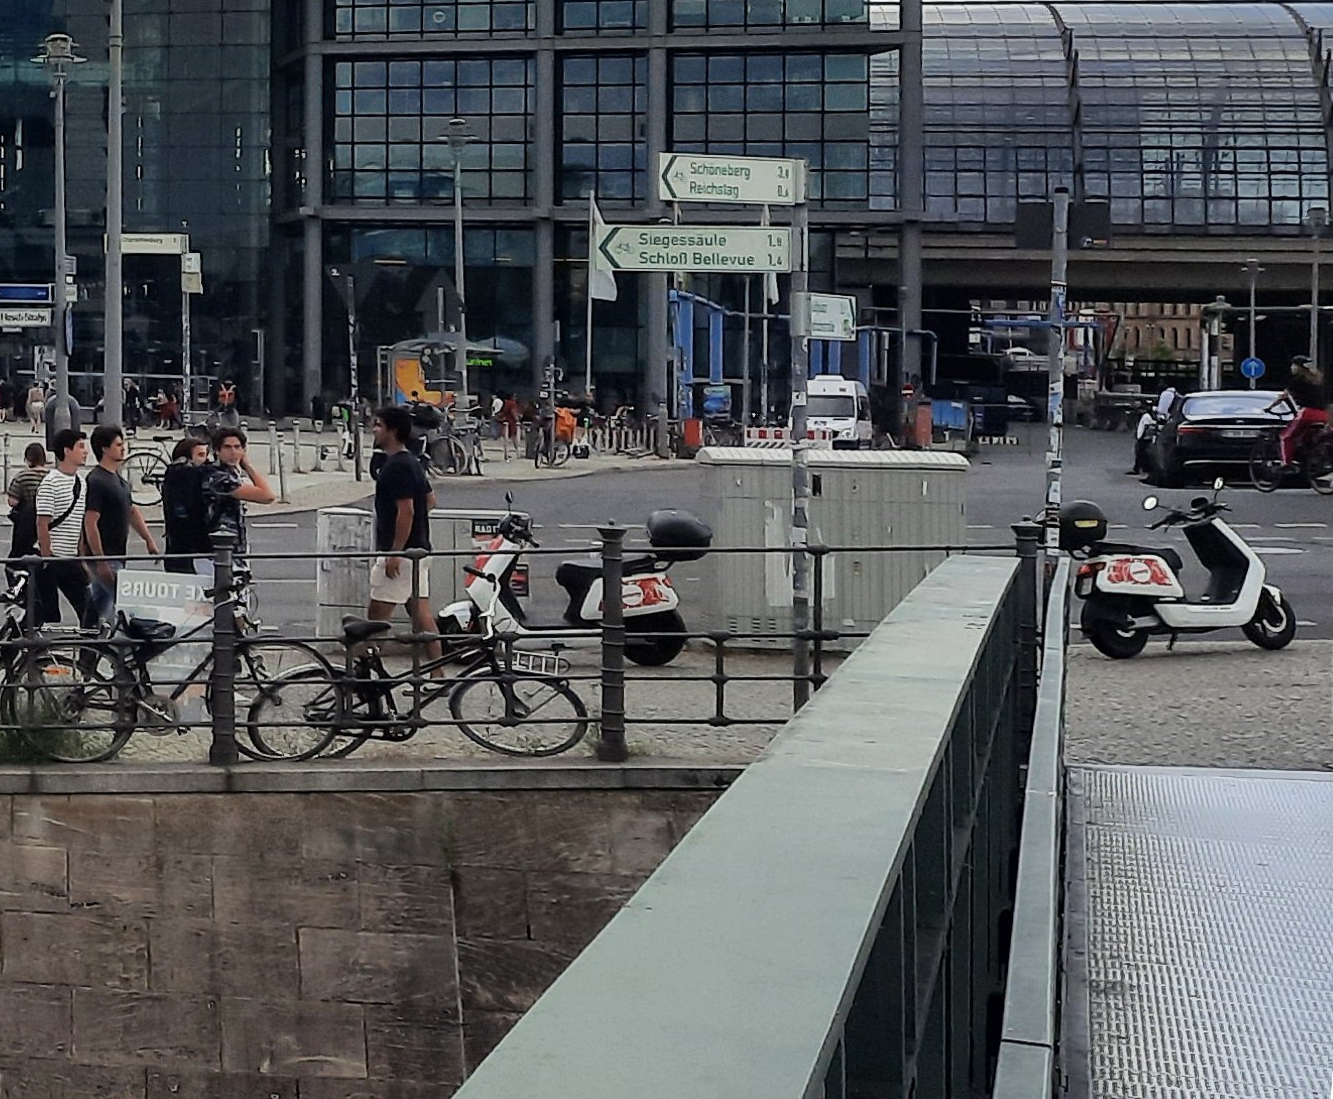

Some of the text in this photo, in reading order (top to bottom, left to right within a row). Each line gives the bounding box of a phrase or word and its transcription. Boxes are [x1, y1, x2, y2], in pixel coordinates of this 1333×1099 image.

[689, 161, 752, 180] Schöneberg
[688, 181, 740, 199] Reichstag
[638, 233, 727, 249] Siegessäule
[639, 252, 688, 266] Schloß
[692, 252, 756, 266] Bellevue
